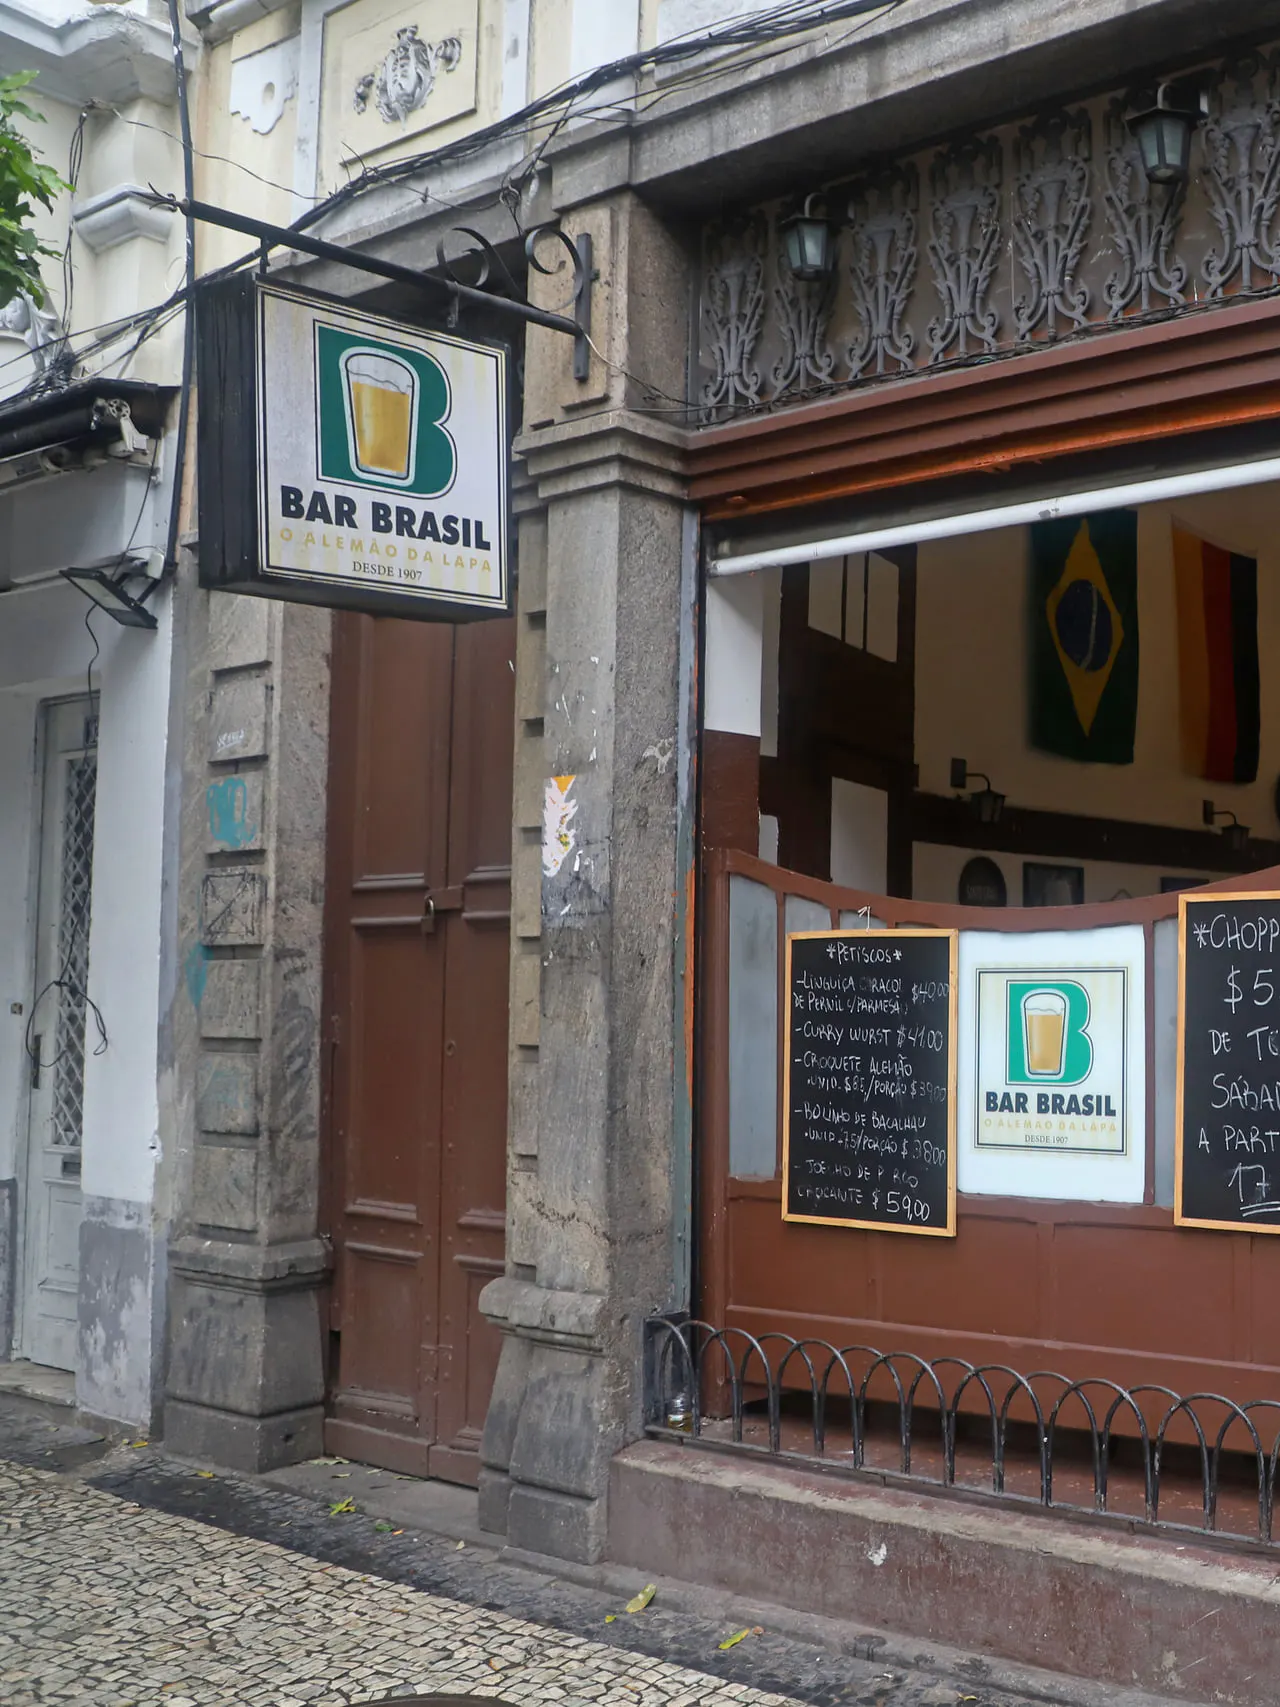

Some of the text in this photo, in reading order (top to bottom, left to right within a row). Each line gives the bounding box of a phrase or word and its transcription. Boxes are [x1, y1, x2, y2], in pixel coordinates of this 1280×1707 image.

[281, 485, 491, 551] BAR BRASIL
[280, 527, 492, 573] O ALEMÃO DA LAPA
[352, 560, 422, 581] DESDE 1907
[849, 1027, 892, 1046] WURST
[1208, 1029, 1232, 1056] DE
[985, 1091, 1117, 1117] BAR BRASIL
[854, 1113, 866, 1126] DE
[872, 1110, 926, 1133] BACALHAU
[984, 1118, 992, 1128] O
[1058, 1121, 1076, 1132] DA
[1081, 1123, 1117, 1133] LAPA
[1024, 1134, 1069, 1145] DESDE 1907
[1198, 1127, 1210, 1153] A
[858, 1163, 870, 1181] DE
[877, 1164, 919, 1188] PRCO
